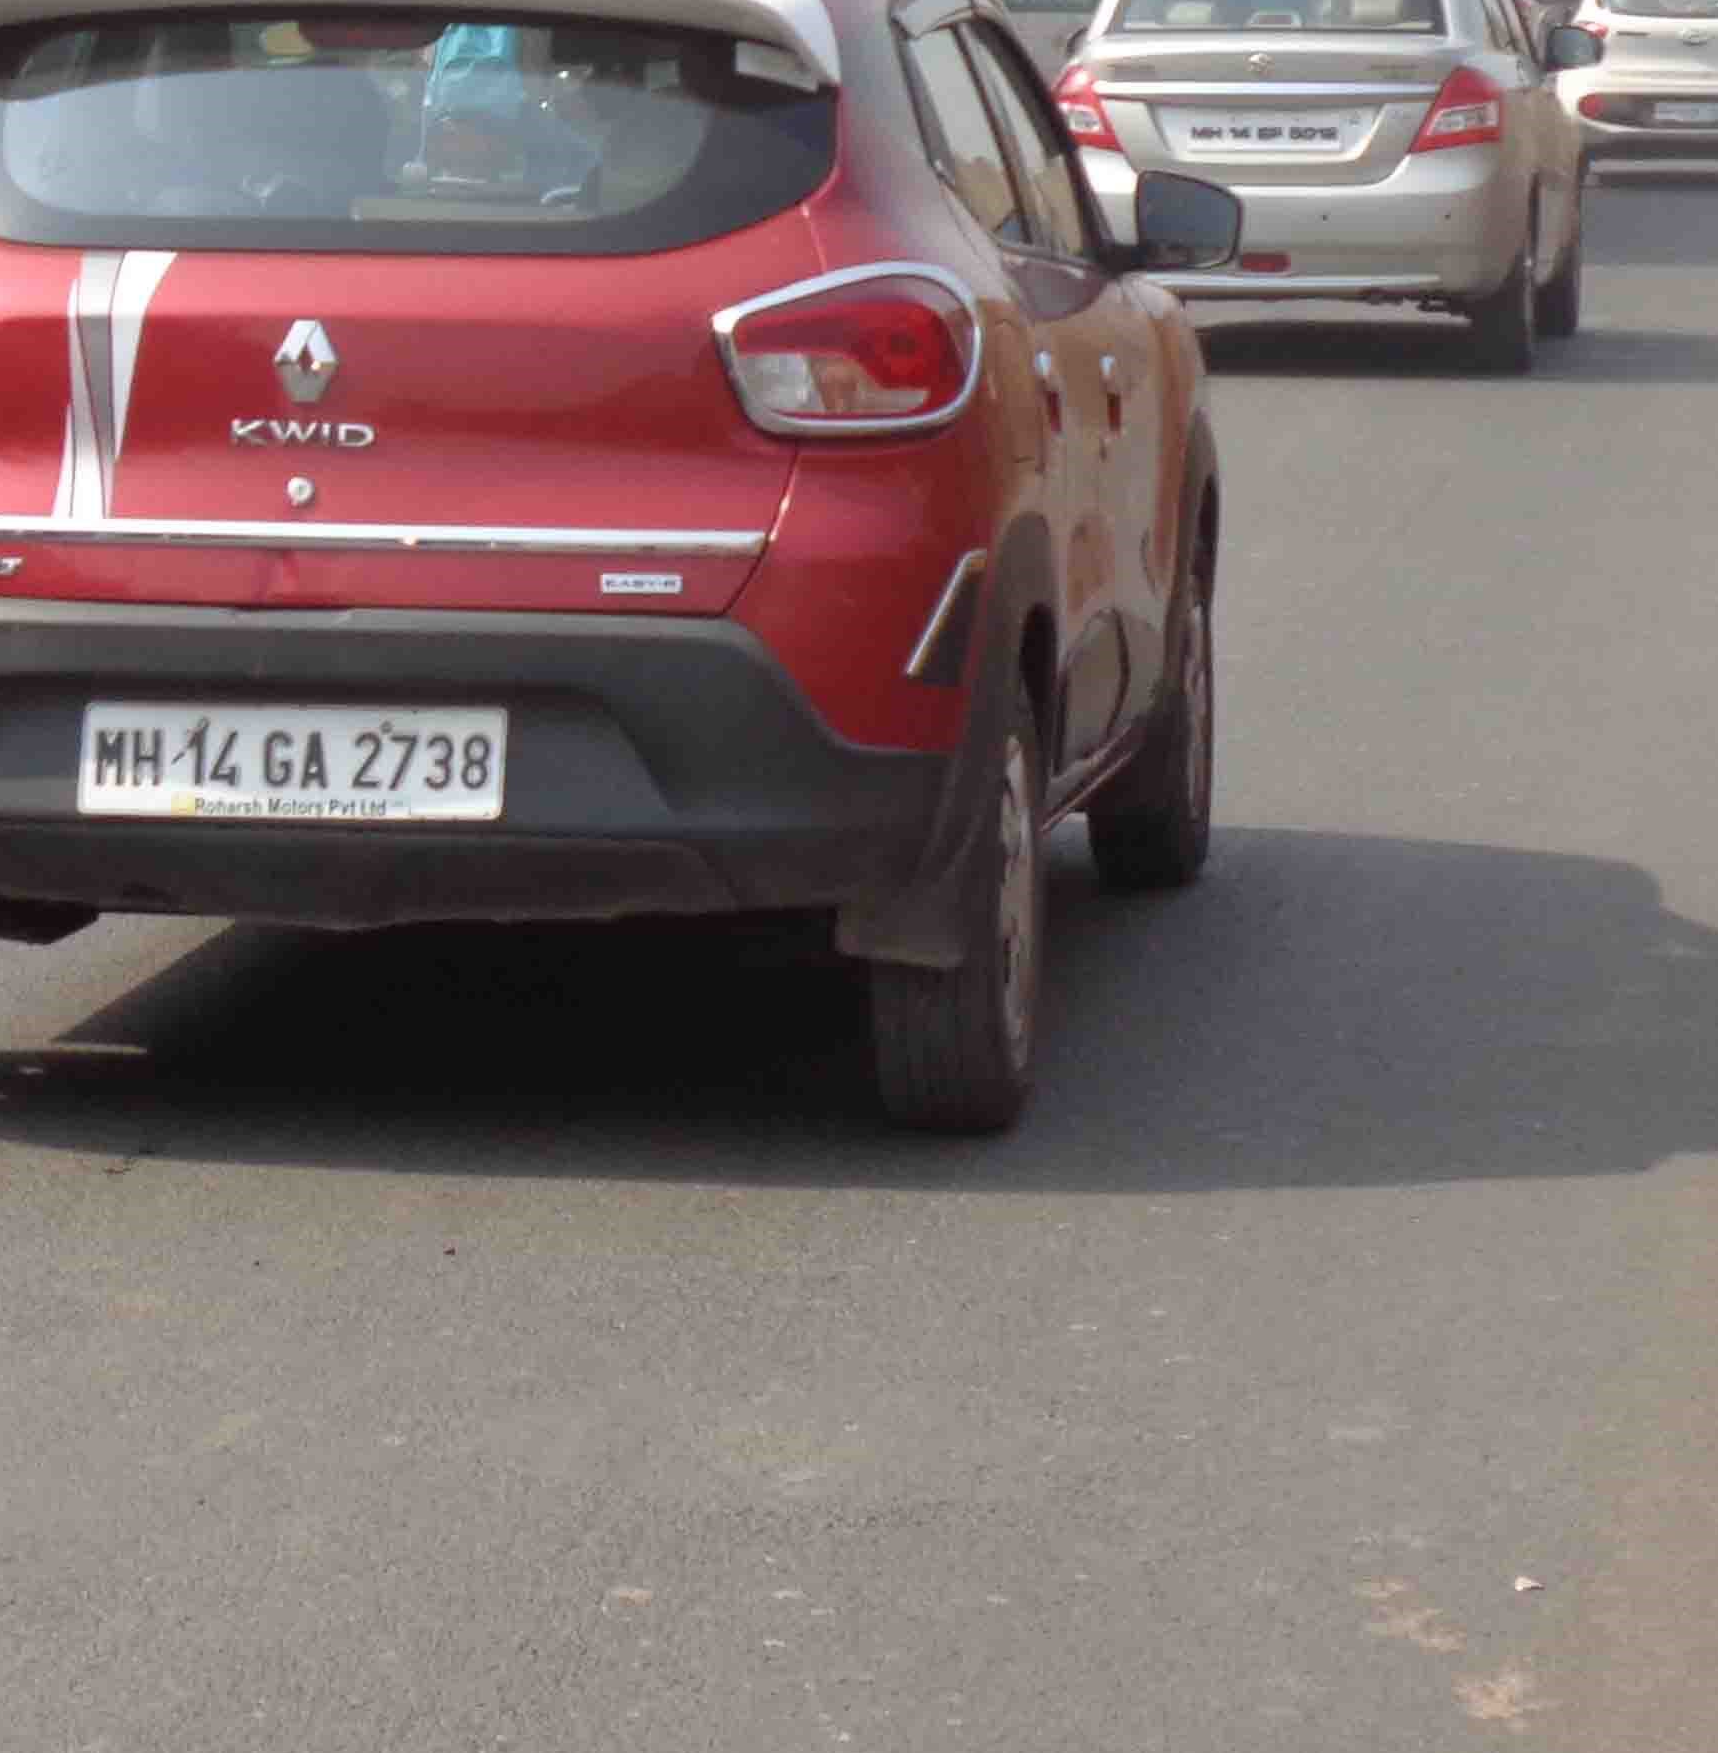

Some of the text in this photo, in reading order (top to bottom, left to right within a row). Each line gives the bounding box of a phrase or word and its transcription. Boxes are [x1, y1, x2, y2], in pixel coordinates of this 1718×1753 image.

[1190, 126, 1222, 140] MH
[229, 417, 376, 448] KWID
[95, 721, 491, 792] MH 14 GA 2738
[267, 798, 325, 818] Motors
[327, 798, 357, 817] Pvt
[359, 798, 386, 817] Ltd
